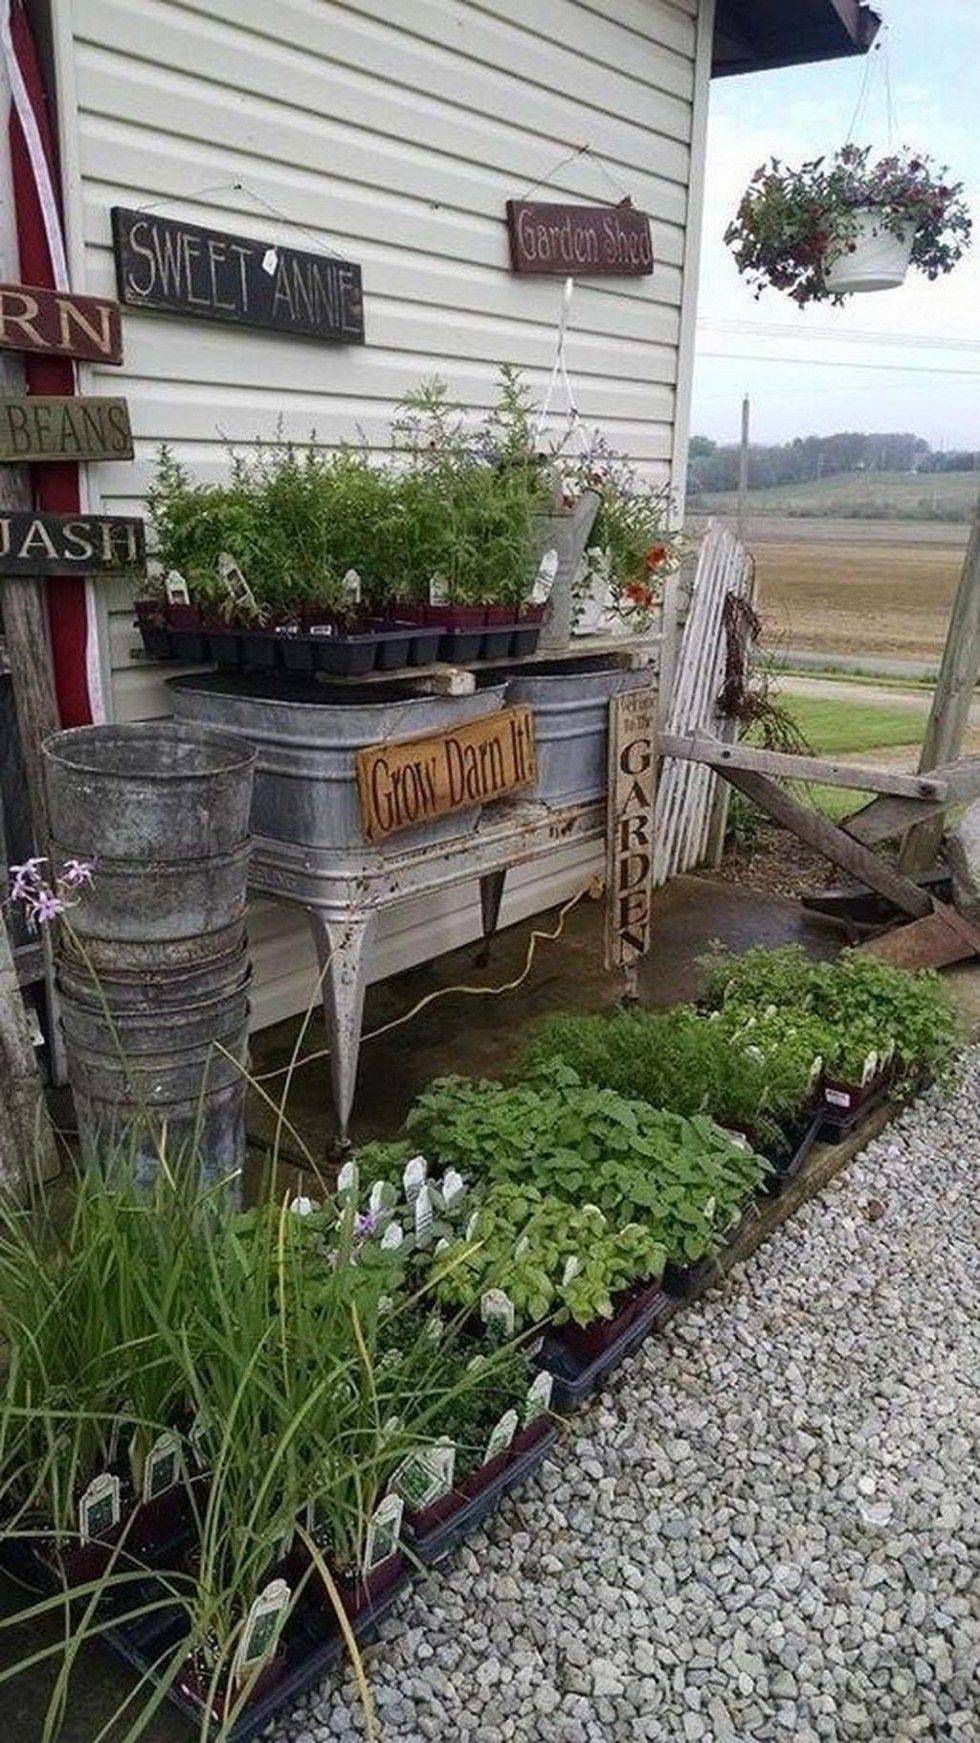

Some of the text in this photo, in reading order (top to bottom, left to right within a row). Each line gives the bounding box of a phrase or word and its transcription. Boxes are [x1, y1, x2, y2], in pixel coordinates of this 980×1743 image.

[129, 221, 362, 331] SWEET ANNIE
[518, 209, 652, 265] Garden Shed
[8, 404, 131, 451] BEANS
[372, 713, 535, 831] Grow Darn It!
[617, 738, 651, 968] GARDEN
